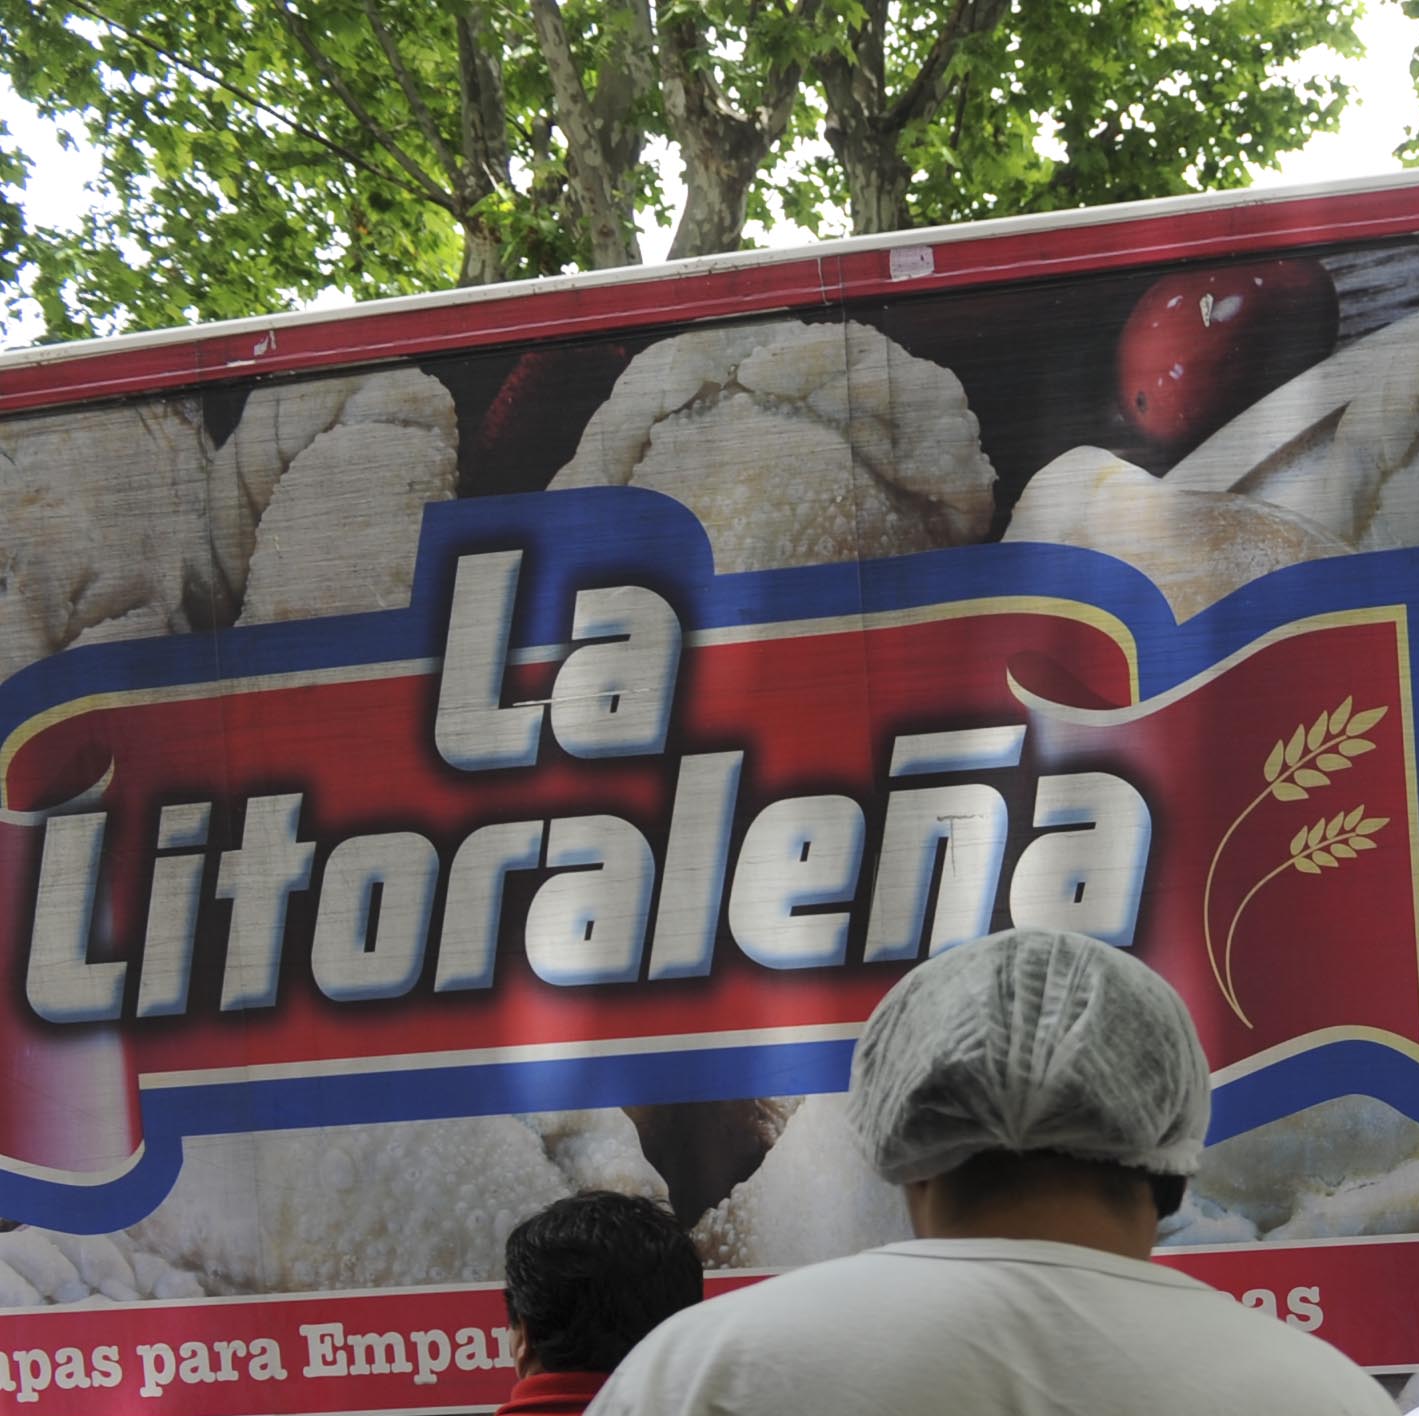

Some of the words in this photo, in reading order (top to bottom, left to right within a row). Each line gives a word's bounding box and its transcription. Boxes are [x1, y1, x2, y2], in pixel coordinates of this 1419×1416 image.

[433, 548, 684, 772] La
[25, 723, 1154, 1024] Litoraleña
[136, 1338, 288, 1398] para
